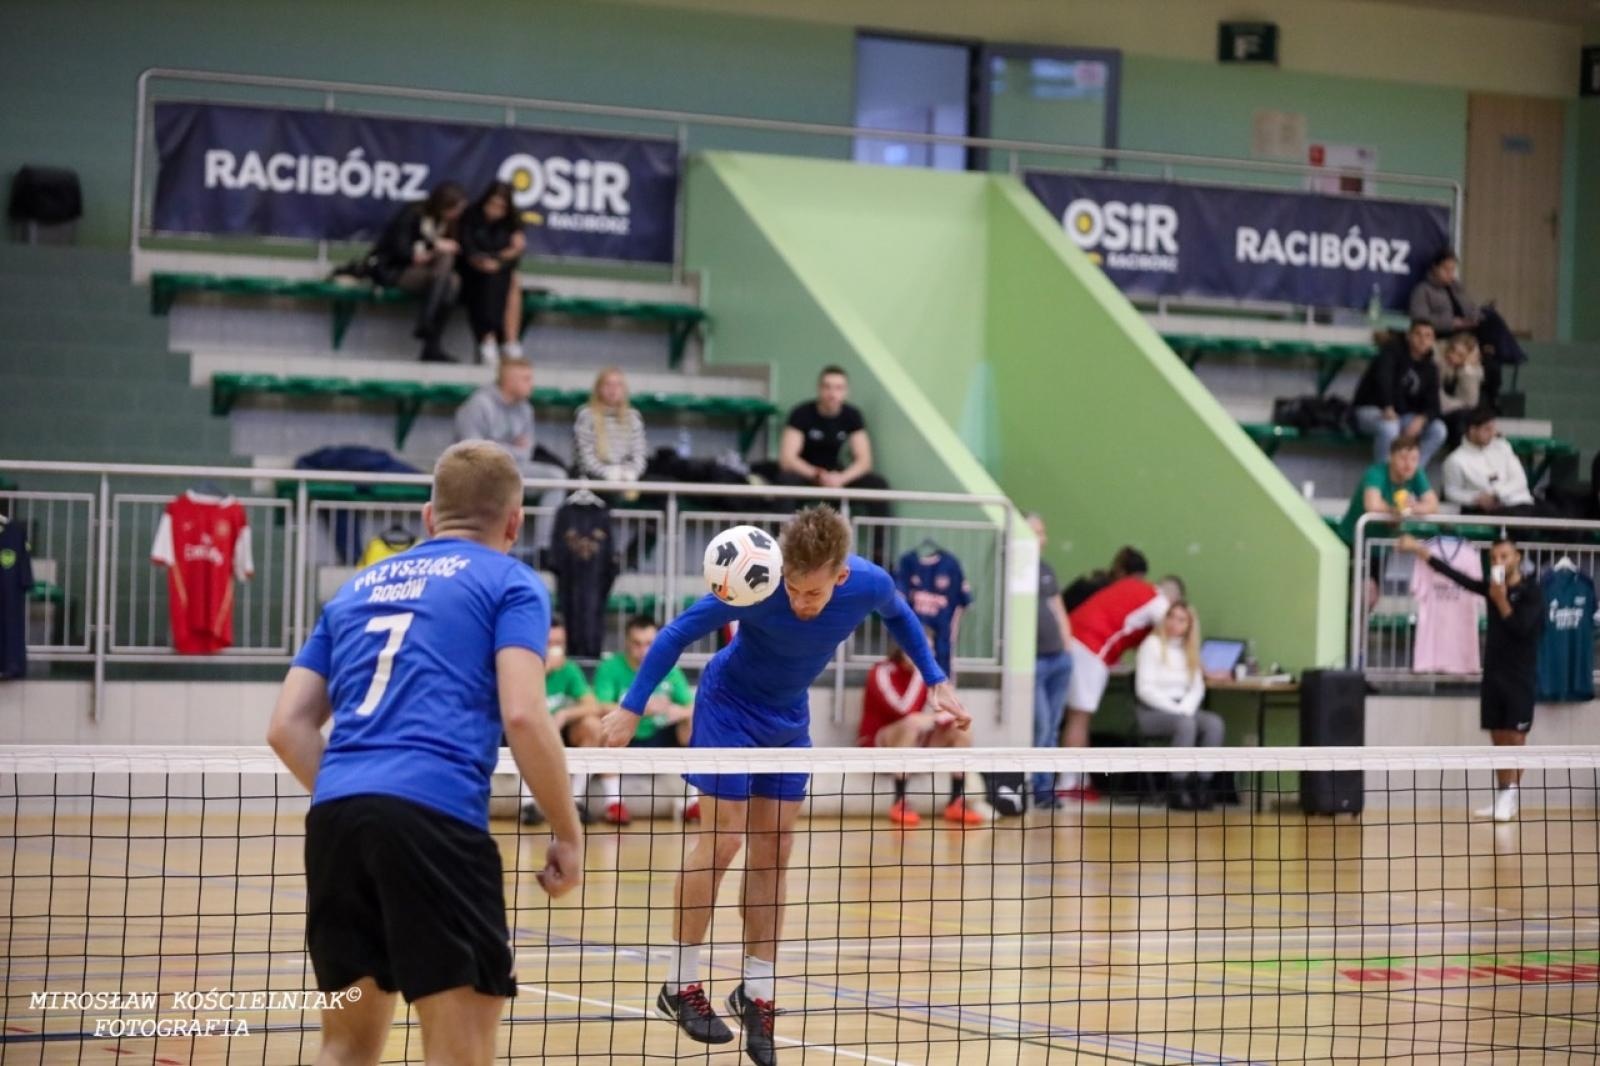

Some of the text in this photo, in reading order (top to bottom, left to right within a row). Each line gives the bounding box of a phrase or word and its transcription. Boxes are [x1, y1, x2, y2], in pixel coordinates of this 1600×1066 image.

[204, 147, 430, 200] RACIBÓRZ
[1235, 225, 1411, 275] RACIBÓRZ
[367, 576, 428, 603] ROGÓW
[355, 612, 415, 717] 7
